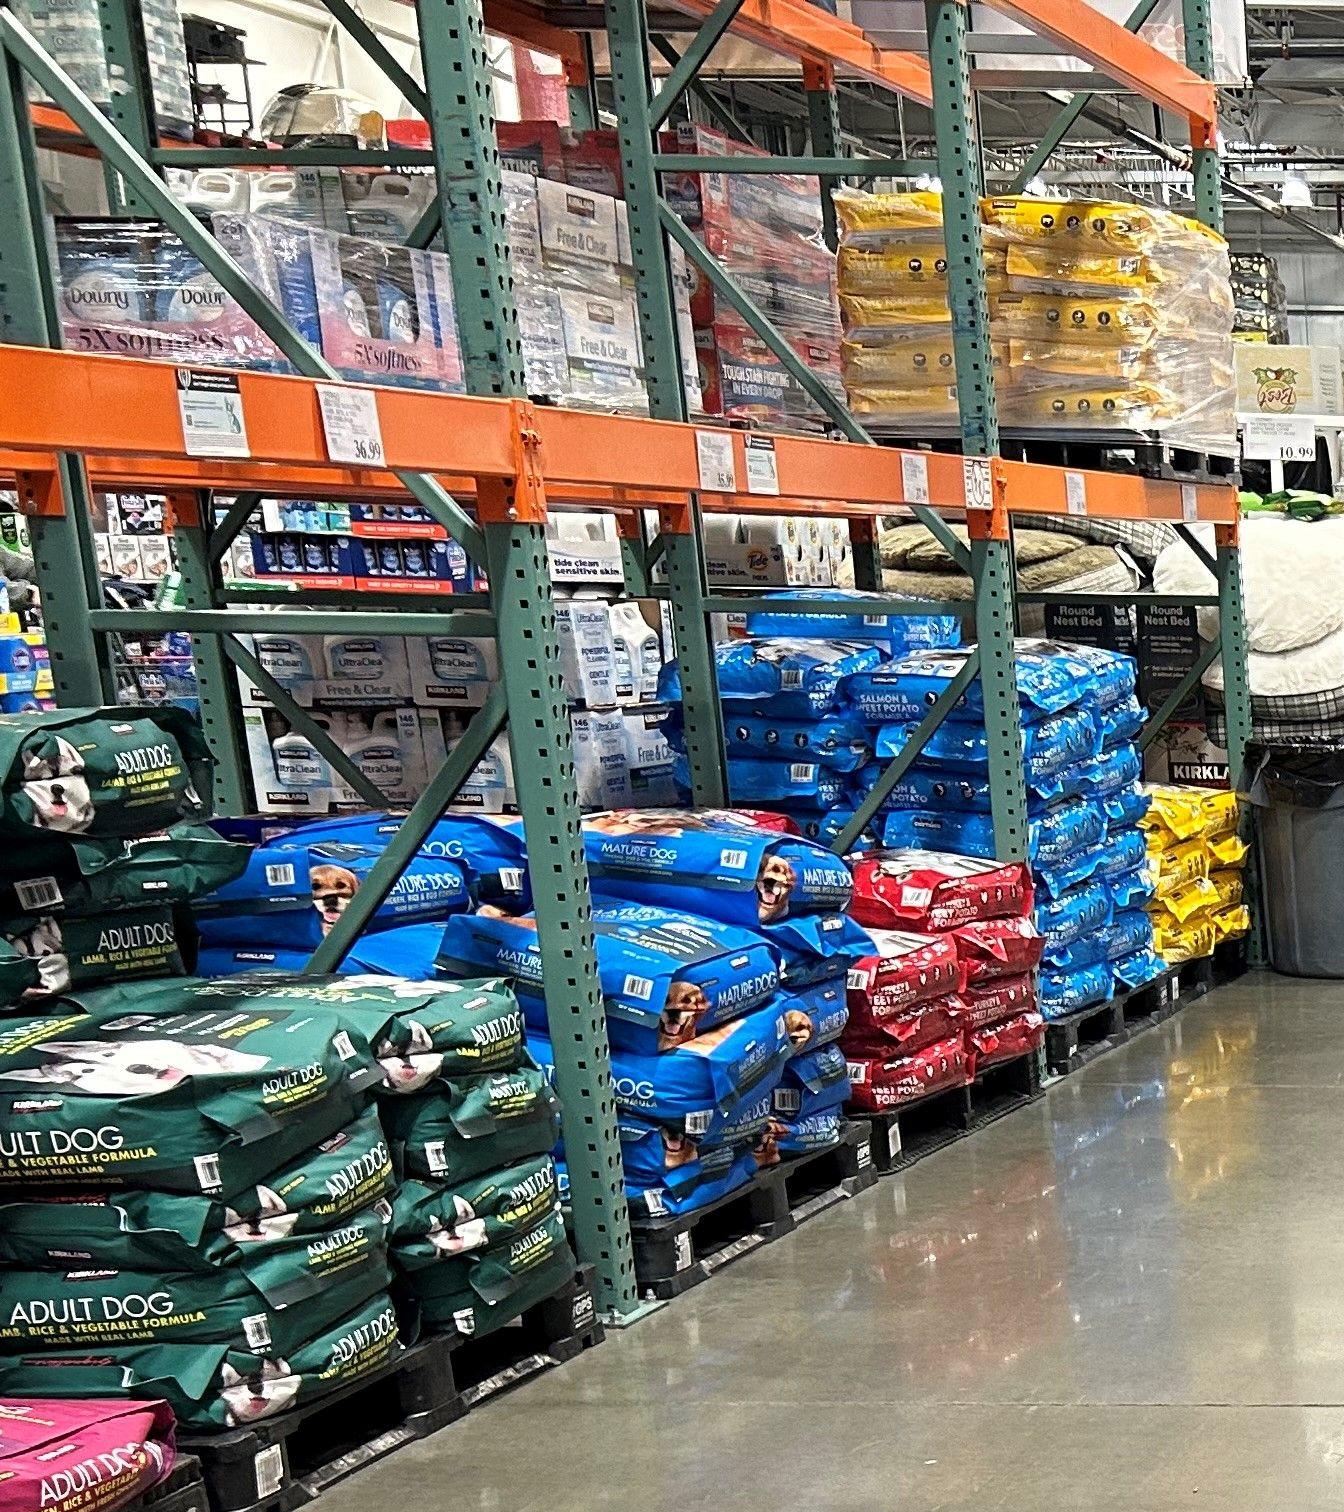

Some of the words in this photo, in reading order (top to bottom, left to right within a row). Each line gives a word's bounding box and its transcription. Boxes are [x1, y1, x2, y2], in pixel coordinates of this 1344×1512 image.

[353, 438, 382, 460] 36.99
[1280, 447, 1313, 458] 10.99
[554, 559, 572, 567] tide
[574, 559, 599, 567] clean
[555, 568, 598, 576] sensitive
[600, 568, 622, 576] skin.
[1059, 605, 1094, 616] Round
[1151, 605, 1183, 616] Round
[1054, 616, 1078, 626] Nest
[1081, 616, 1102, 626] Bed
[1144, 616, 1168, 626] Nest
[1170, 616, 1190, 626] Bed
[326, 685, 349, 695] Free
[363, 685, 391, 696] Clear
[860, 694, 899, 702] SALMON
[883, 704, 919, 712] POTATO
[114, 748, 146, 775] ADULT
[147, 743, 172, 767] DOG
[601, 843, 647, 857] MATURE
[650, 847, 677, 859] DOG
[98, 925, 140, 952] ADULT
[718, 980, 754, 1008] MATURE
[754, 972, 777, 994] DOG
[470, 1019, 500, 1047] ADULT
[262, 1074, 299, 1096] ADULT
[300, 1061, 323, 1082] DOG
[50, 1126, 124, 1154] DOG
[20, 1155, 89, 1167] VEGETABLE
[92, 1147, 157, 1163] FORMULA
[51, 1166, 75, 1175] REAL
[77, 1165, 104, 1174] LAMB
[325, 1159, 364, 1200] ADULT
[363, 1141, 389, 1176] DOG
[307, 1234, 342, 1257] ADULT
[343, 1225, 364, 1242] DOG
[510, 1238, 531, 1257] ADULT
[531, 1226, 548, 1244] DOG
[10, 1298, 94, 1326] ADULT
[103, 1292, 174, 1318] DOG
[29, 1325, 55, 1336] RICE
[60, 1324, 69, 1334] &
[71, 1320, 140, 1334] VEGETABLE
[143, 1311, 206, 1329] FORMULA
[44, 1336, 71, 1344] MADE
[74, 1334, 96, 1343] WITH
[100, 1333, 124, 1342] REAL
[126, 1330, 154, 1340] LAMB
[332, 1327, 370, 1365] ADULT
[39, 1463, 100, 1507] ADULT
[84, 1493, 94, 1504] &
